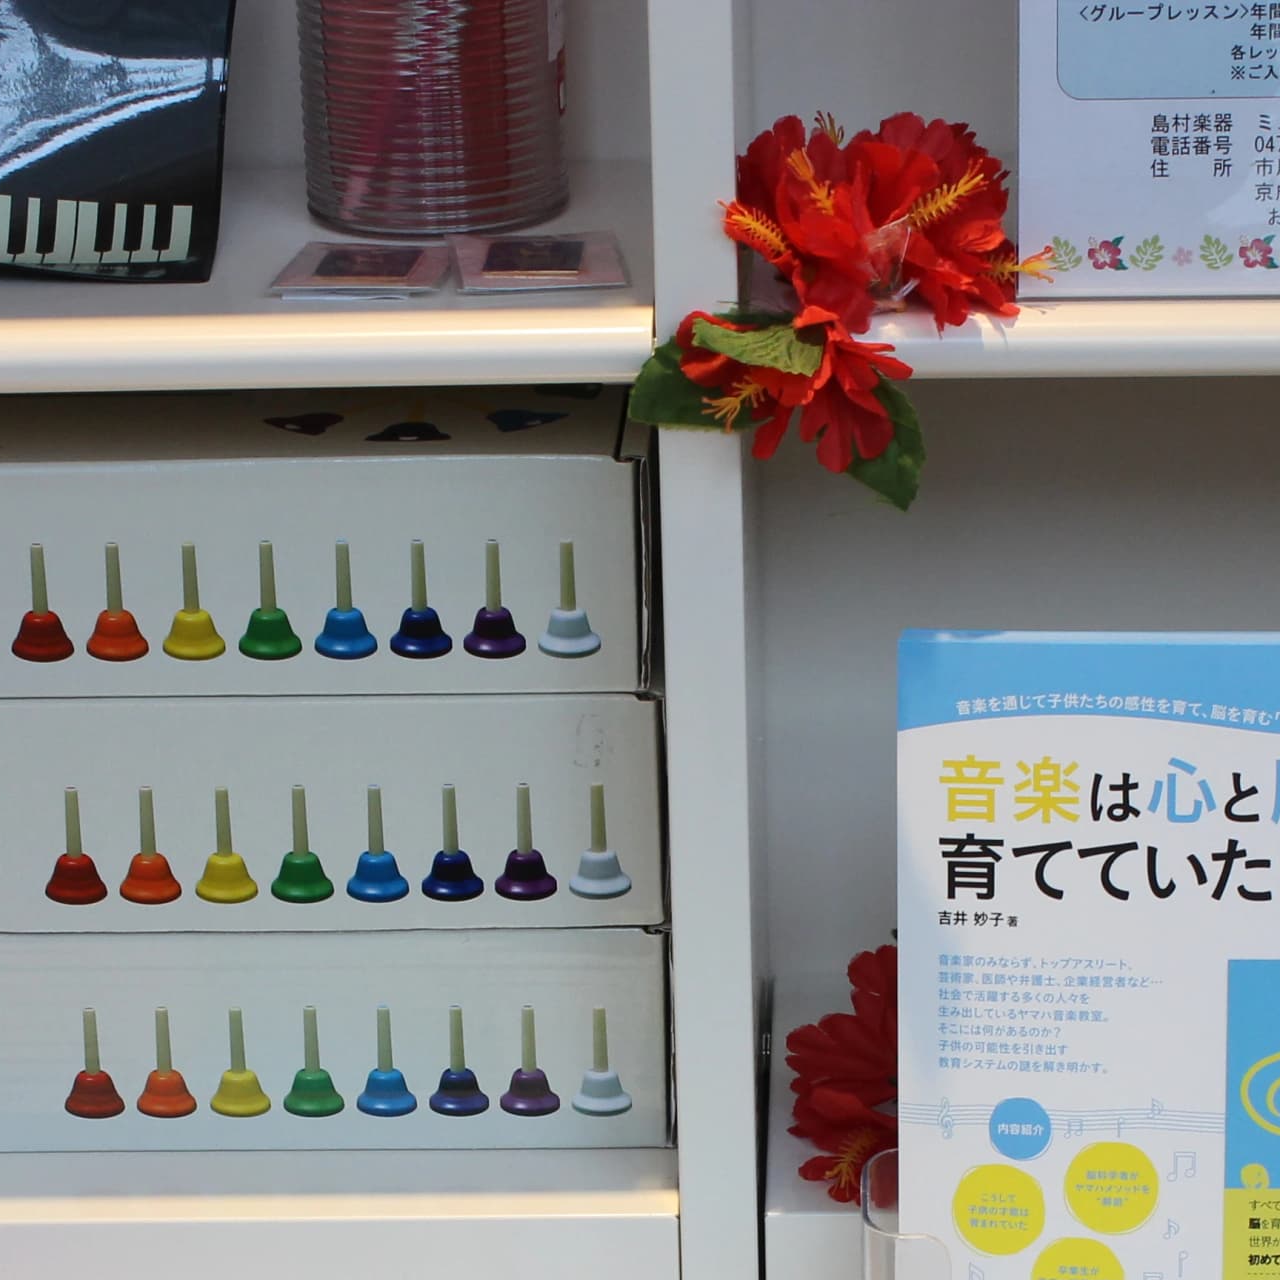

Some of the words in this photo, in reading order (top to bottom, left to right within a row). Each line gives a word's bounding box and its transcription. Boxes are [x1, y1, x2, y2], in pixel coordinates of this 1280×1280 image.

[1151, 113, 1233, 133] 島村楽器
[1150, 136, 1232, 156] 電話番号
[938, 832, 1274, 903] 育てていた
[938, 910, 968, 926] 吉井
[973, 911, 1004, 928] 妙子
[938, 1039, 1068, 1056] 子供の可能性を引き出す
[997, 1123, 1045, 1136] 内容紹介
